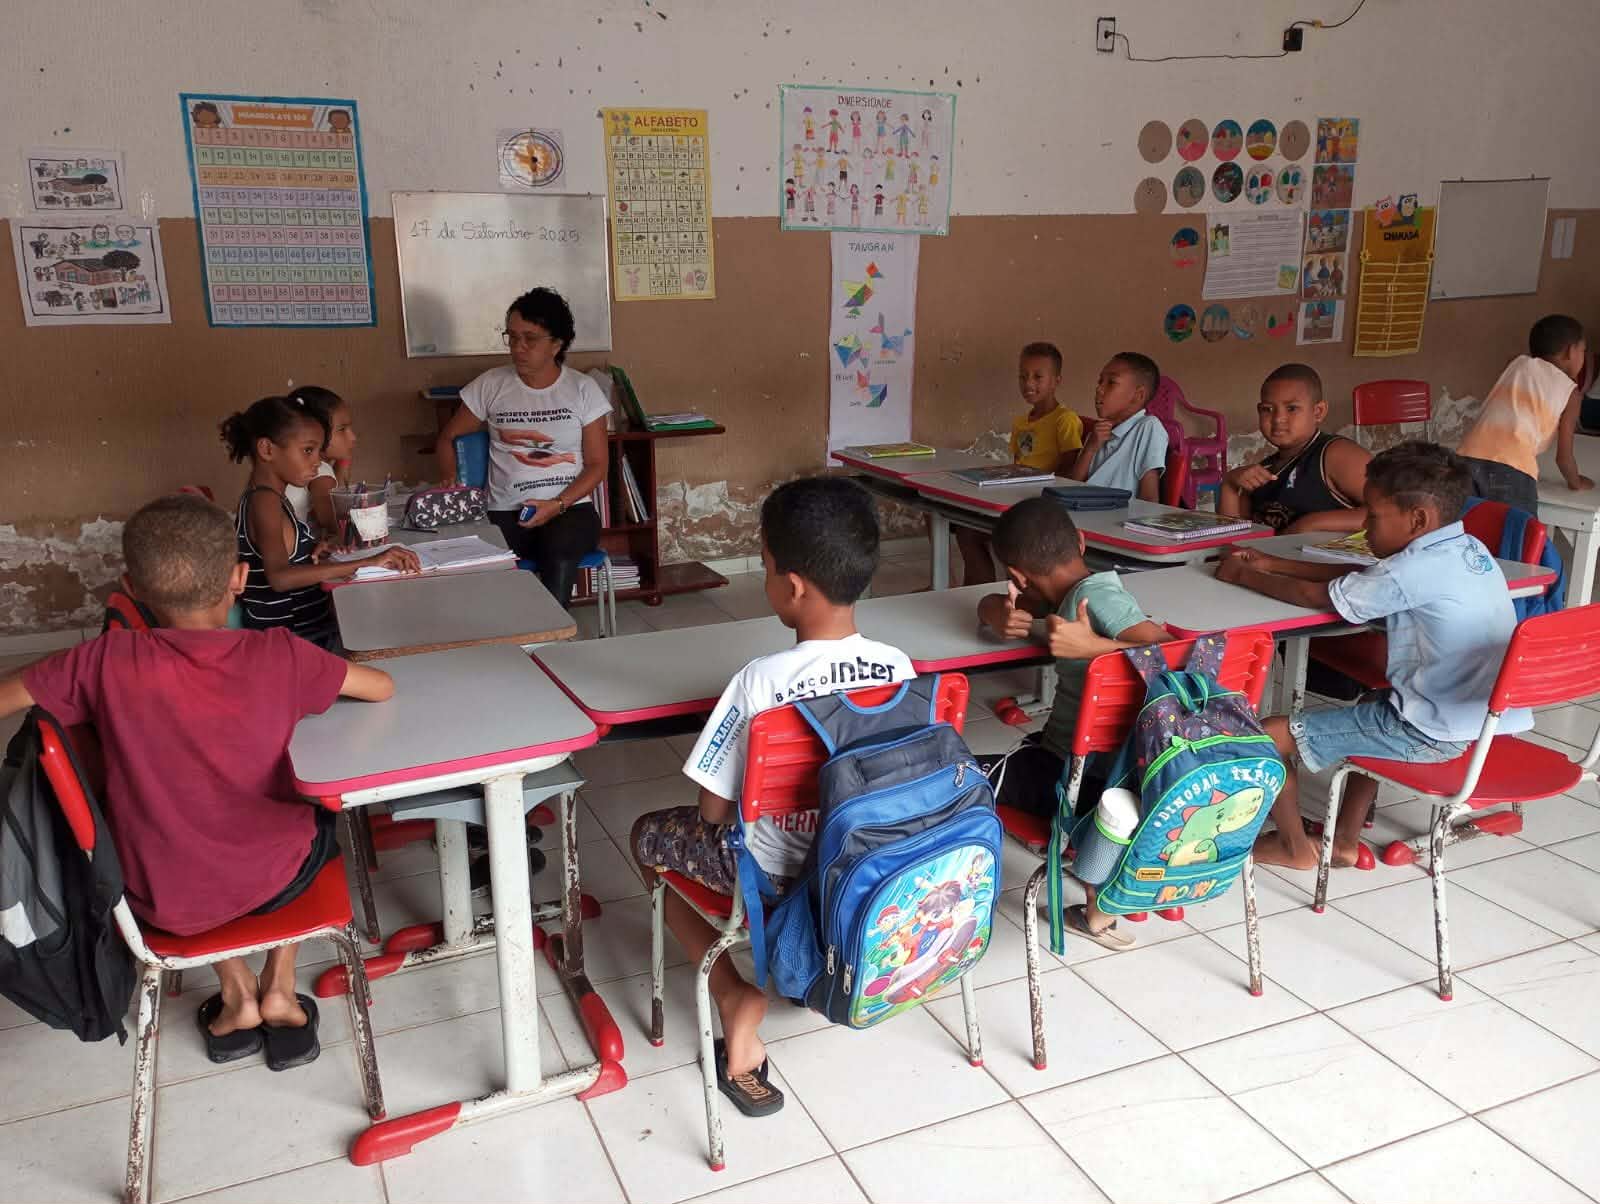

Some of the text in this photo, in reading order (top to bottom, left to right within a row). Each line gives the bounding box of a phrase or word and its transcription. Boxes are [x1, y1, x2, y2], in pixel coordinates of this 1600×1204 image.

[634, 115, 698, 128] ALFABETO
[409, 219, 432, 238] 17
[437, 221, 457, 239] de
[550, 414, 572, 422] NOVA
[775, 675, 829, 702] BANCO
[698, 706, 740, 772] CORR PLASTIK
